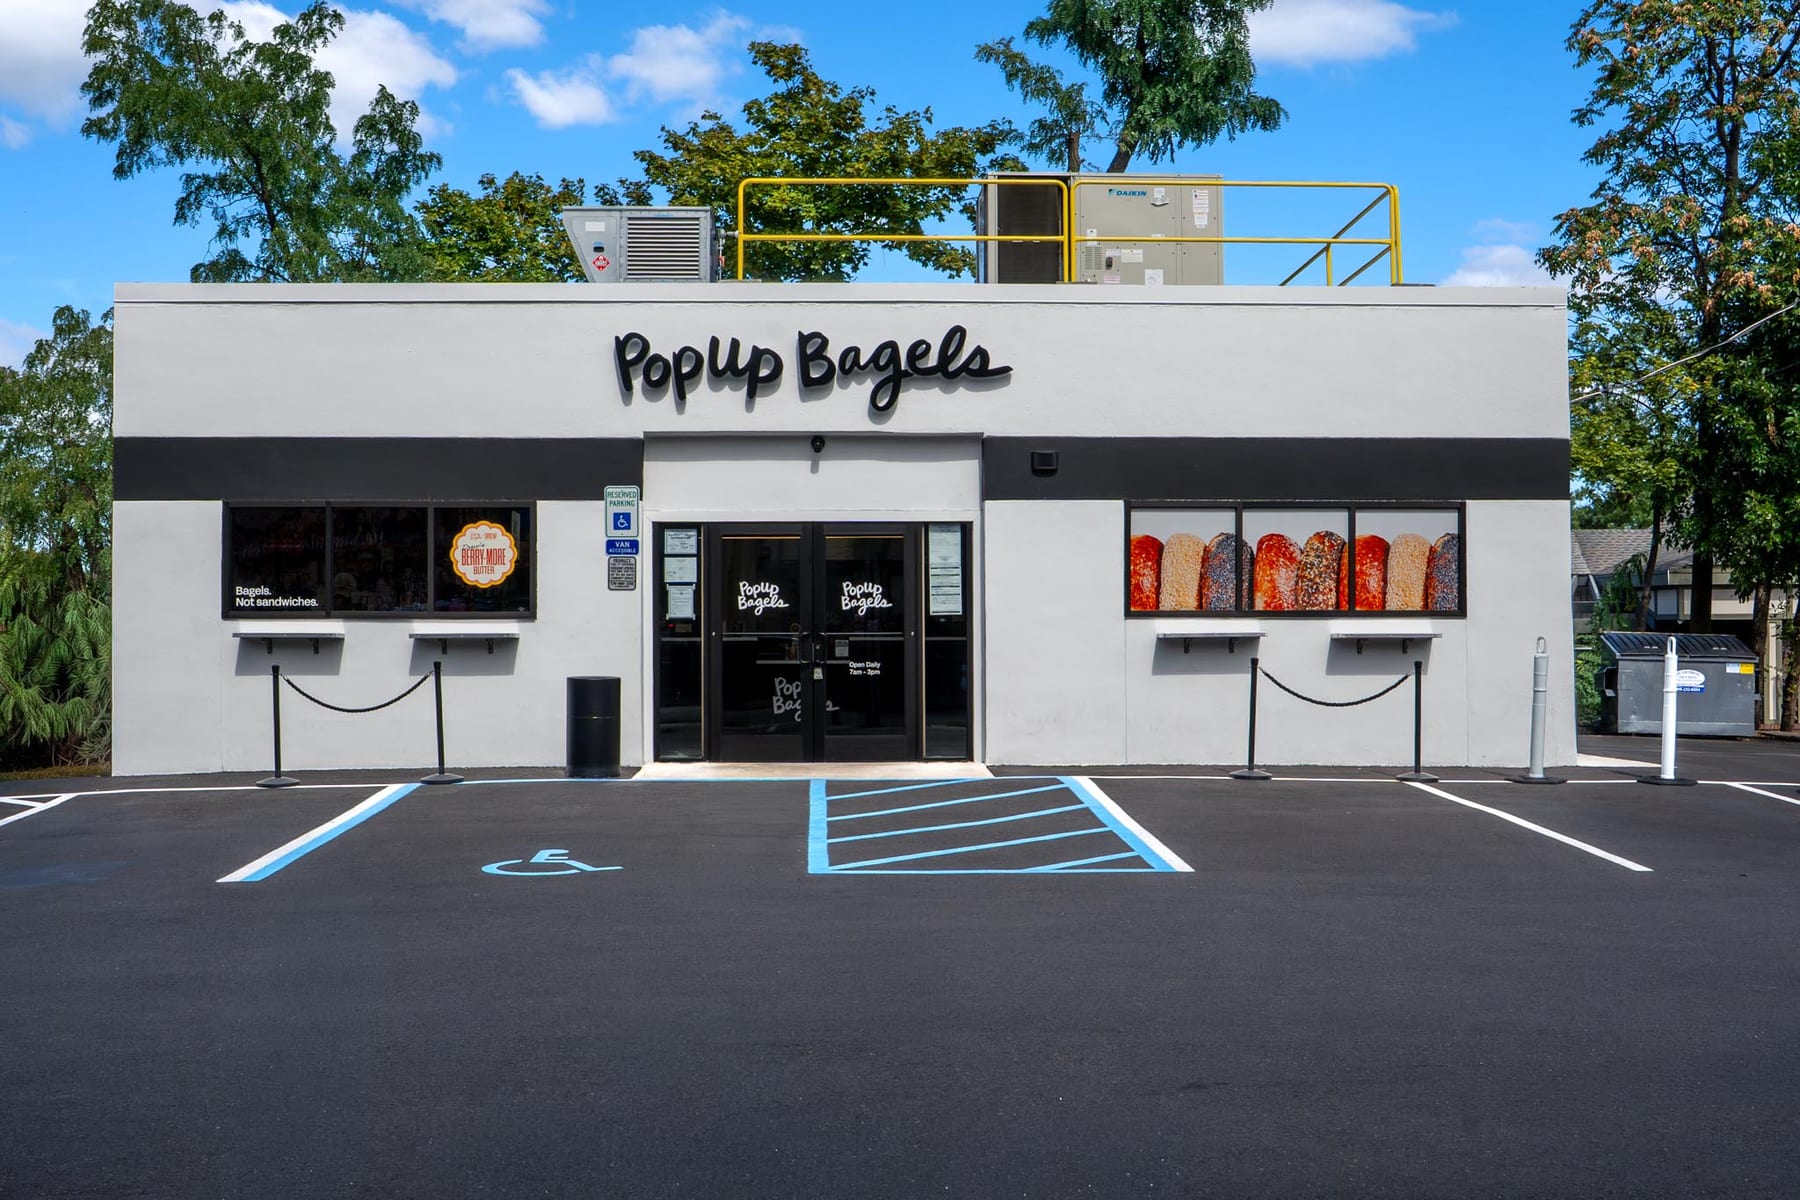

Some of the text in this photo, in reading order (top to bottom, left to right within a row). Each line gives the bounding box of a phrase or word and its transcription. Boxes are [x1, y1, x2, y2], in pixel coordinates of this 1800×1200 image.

[614, 324, 1014, 413] PopUp Bagels
[461, 548, 506, 566] BERRY-MORE
[473, 566, 495, 575] BUTTER
[235, 585, 272, 598] Bagels.
[738, 580, 780, 598] PopUp
[842, 580, 883, 598] PopUp
[235, 596, 319, 607] Not sandwiches.
[737, 594, 790, 616] Bagels
[841, 594, 893, 616] Bagels
[848, 661, 881, 669] Open Daily
